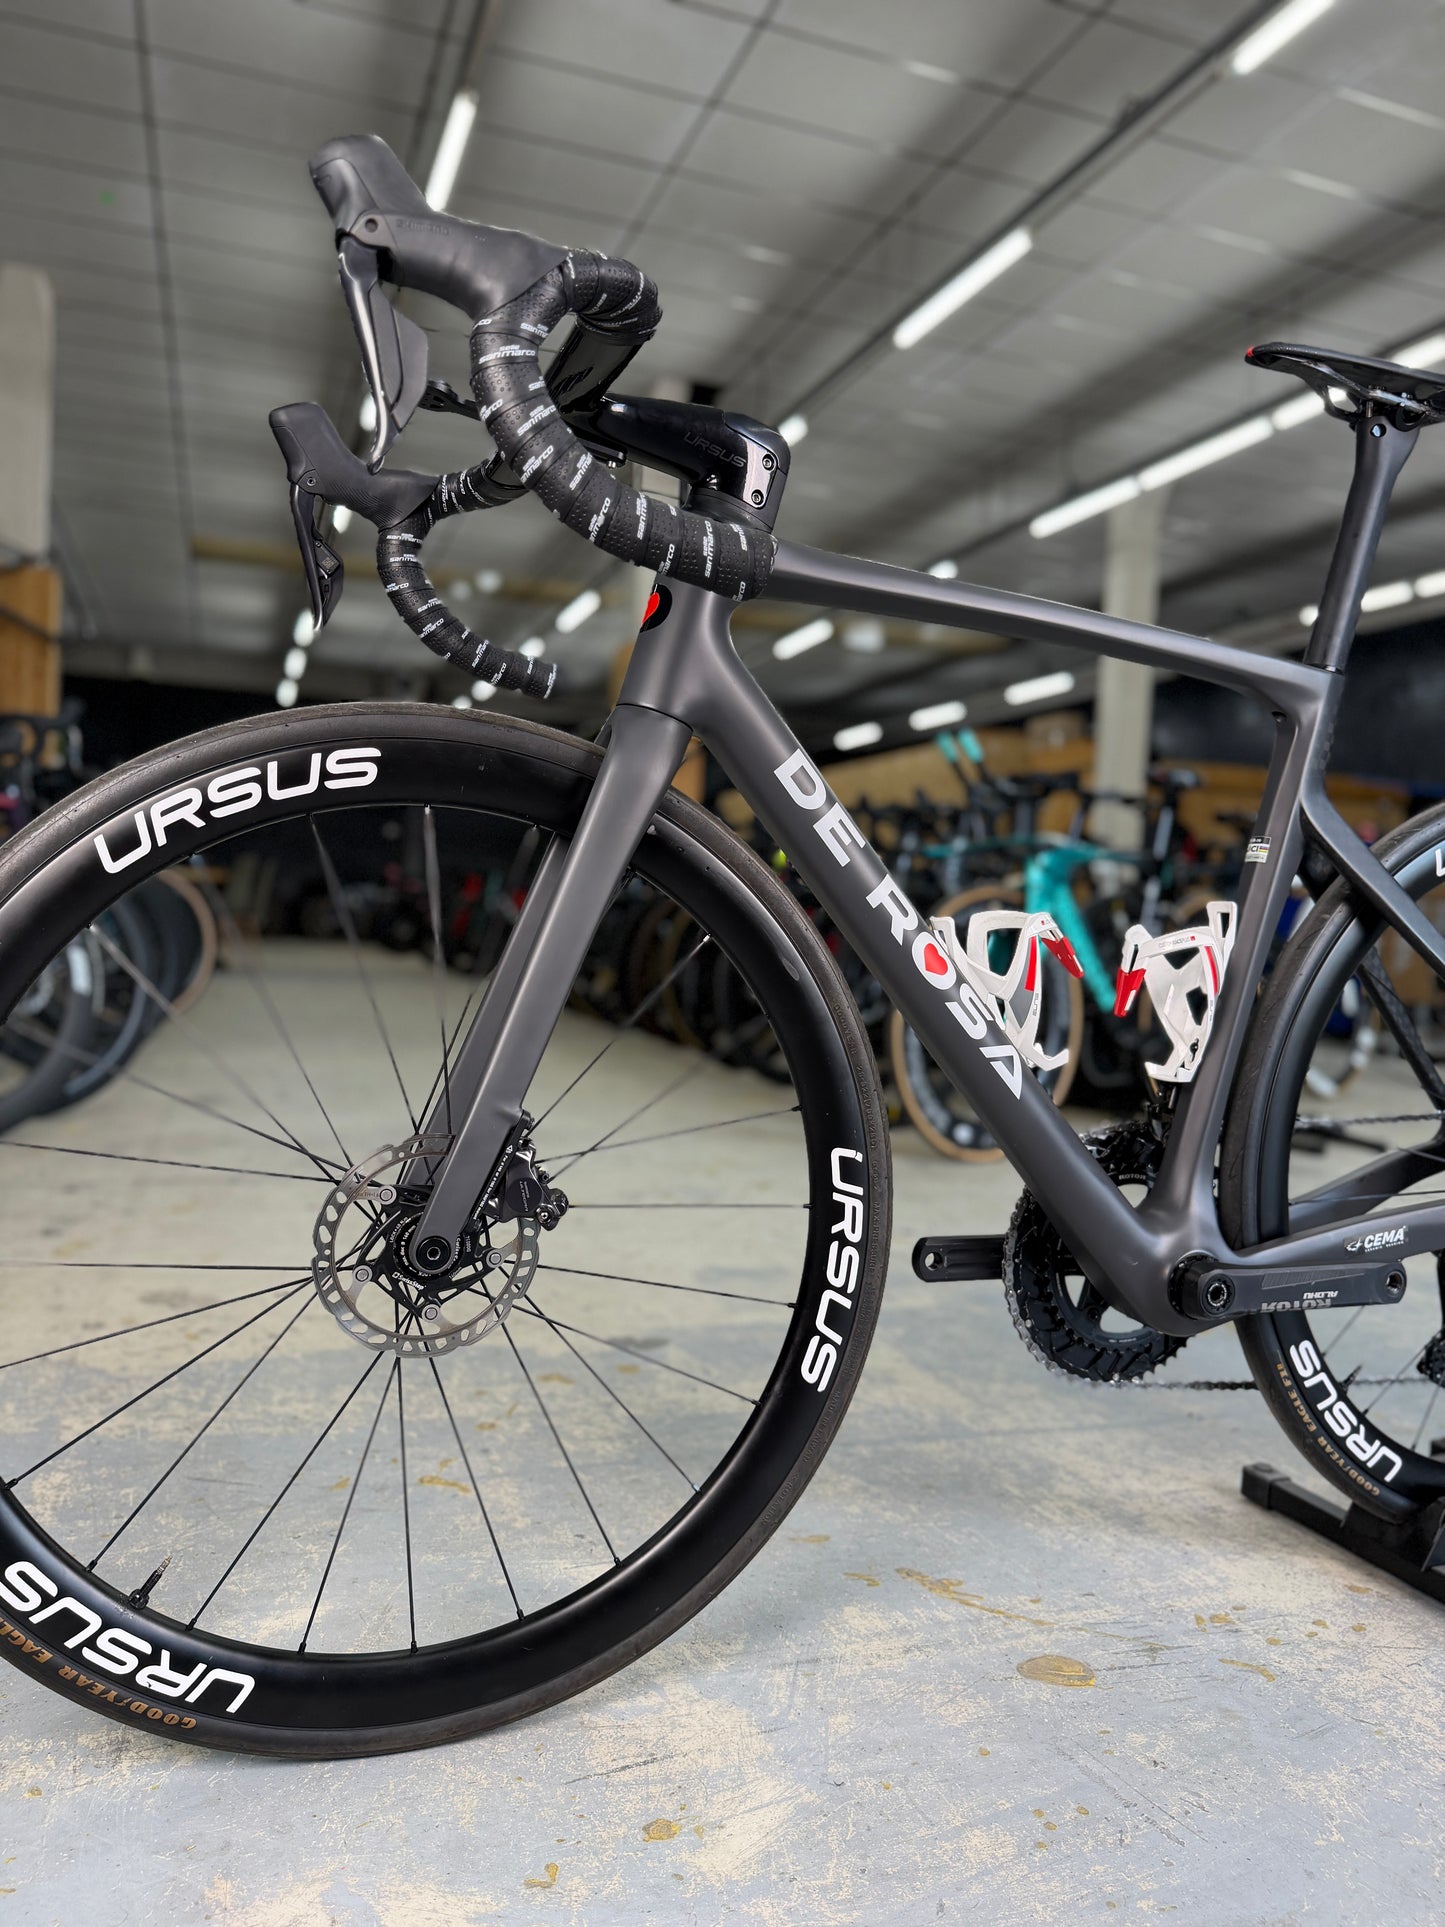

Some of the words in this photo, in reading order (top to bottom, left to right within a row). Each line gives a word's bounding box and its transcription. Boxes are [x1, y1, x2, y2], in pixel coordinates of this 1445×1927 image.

[684, 431, 746, 468] URSUS
[94, 747, 382, 875] URSUS
[774, 748, 866, 867] DE
[866, 874, 1022, 1099] ROSA
[801, 1147, 864, 1392] URSUS
[1364, 1227, 1404, 1249] CEMA
[1288, 1389, 1317, 1432] EAGLE
[1290, 1340, 1402, 1483] URSUS
[1317, 1436, 1380, 1496] GOODYEAR
[0, 1561, 255, 1714] URSUS
[0, 1616, 53, 1664] EAGL
[56, 1664, 197, 1729] GOODYEAR
